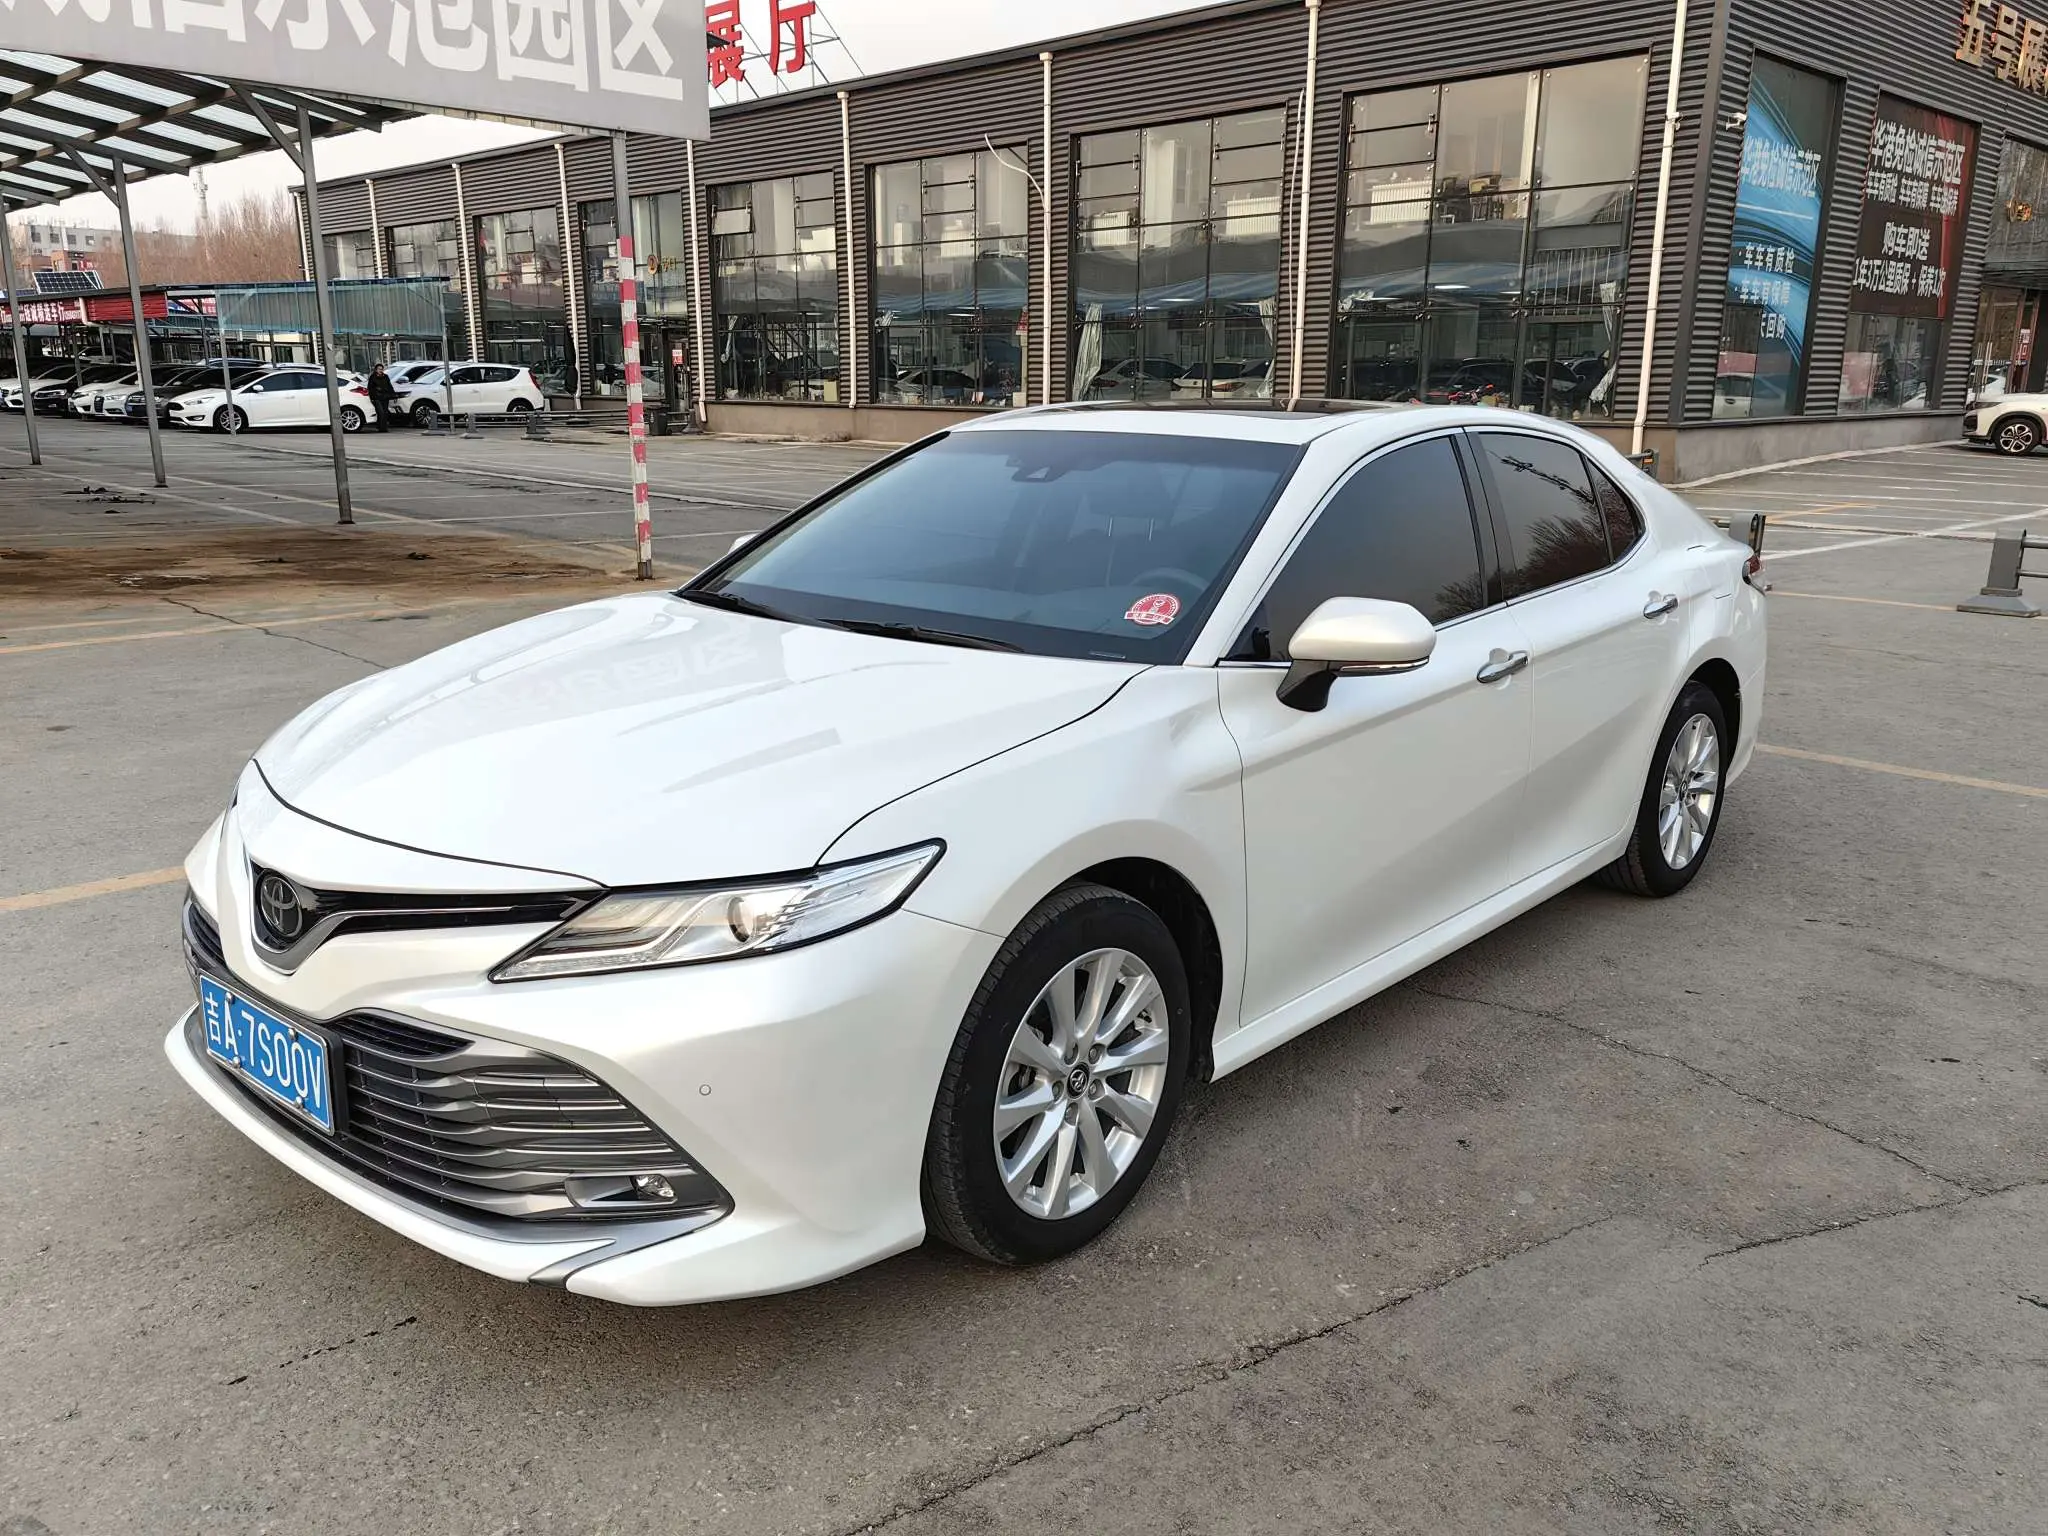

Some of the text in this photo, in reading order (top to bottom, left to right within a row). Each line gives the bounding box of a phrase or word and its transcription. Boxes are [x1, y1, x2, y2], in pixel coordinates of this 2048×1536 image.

[1956, 0, 2048, 98] 五号展
[1882, 221, 1931, 261] 购车即送
